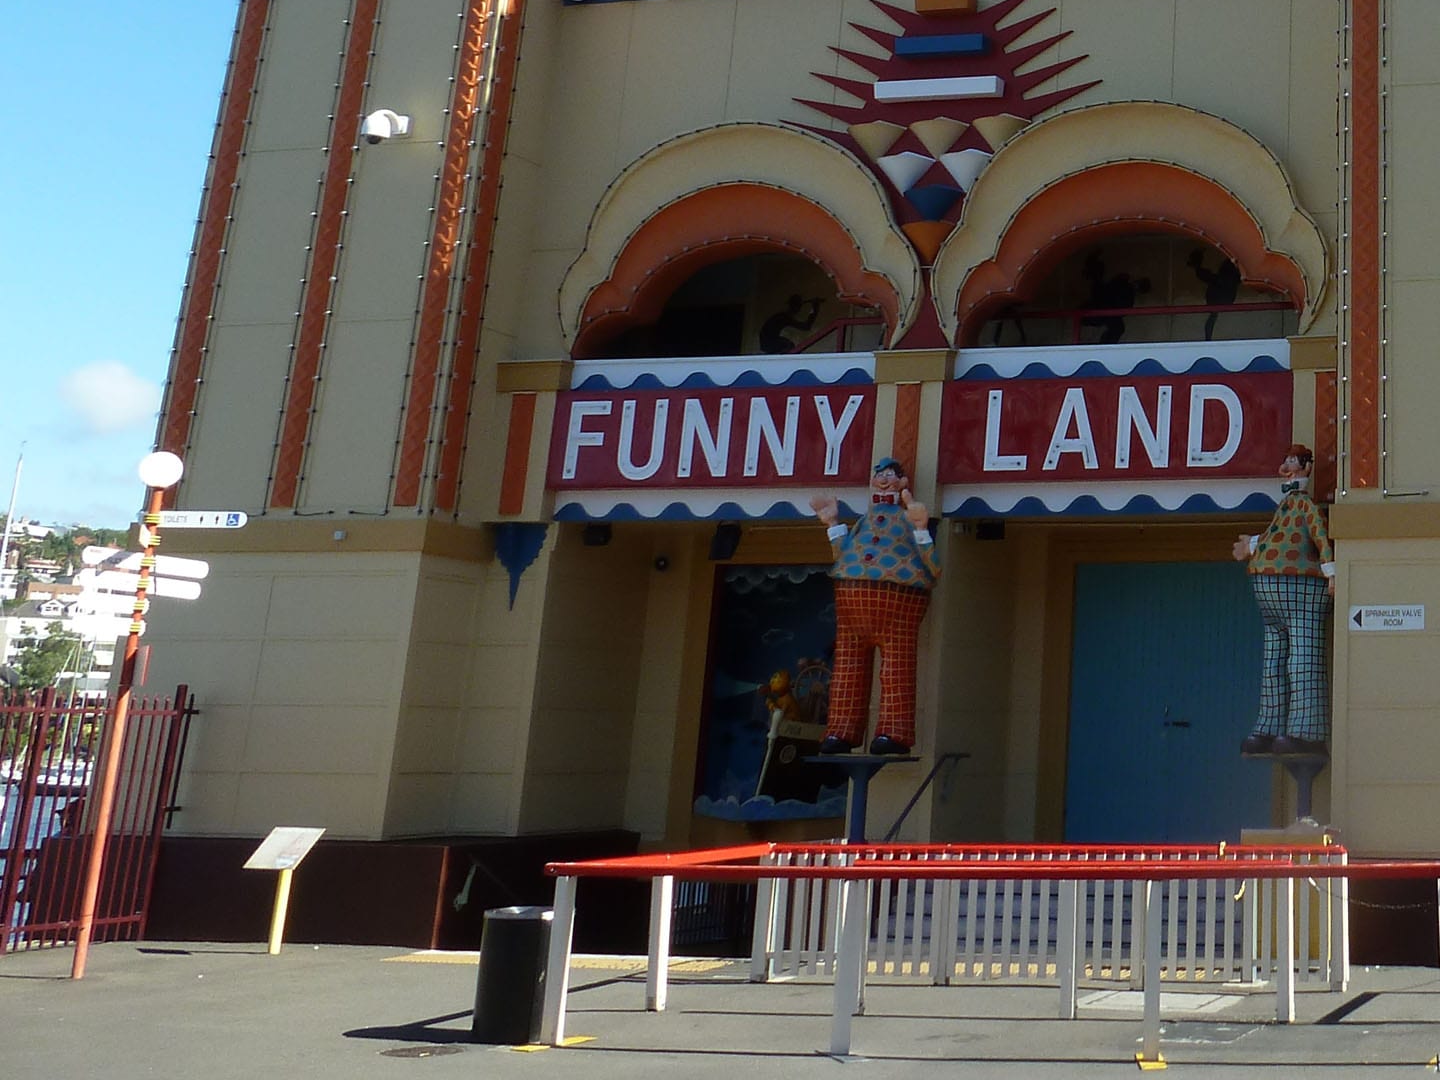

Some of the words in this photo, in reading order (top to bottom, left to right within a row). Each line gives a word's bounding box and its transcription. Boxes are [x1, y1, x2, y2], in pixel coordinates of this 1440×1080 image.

[561, 394, 865, 482] FUNNY
[983, 383, 1244, 473] LAND
[1401, 608, 1422, 617] VALVE
[1383, 618, 1404, 626] ROOM
